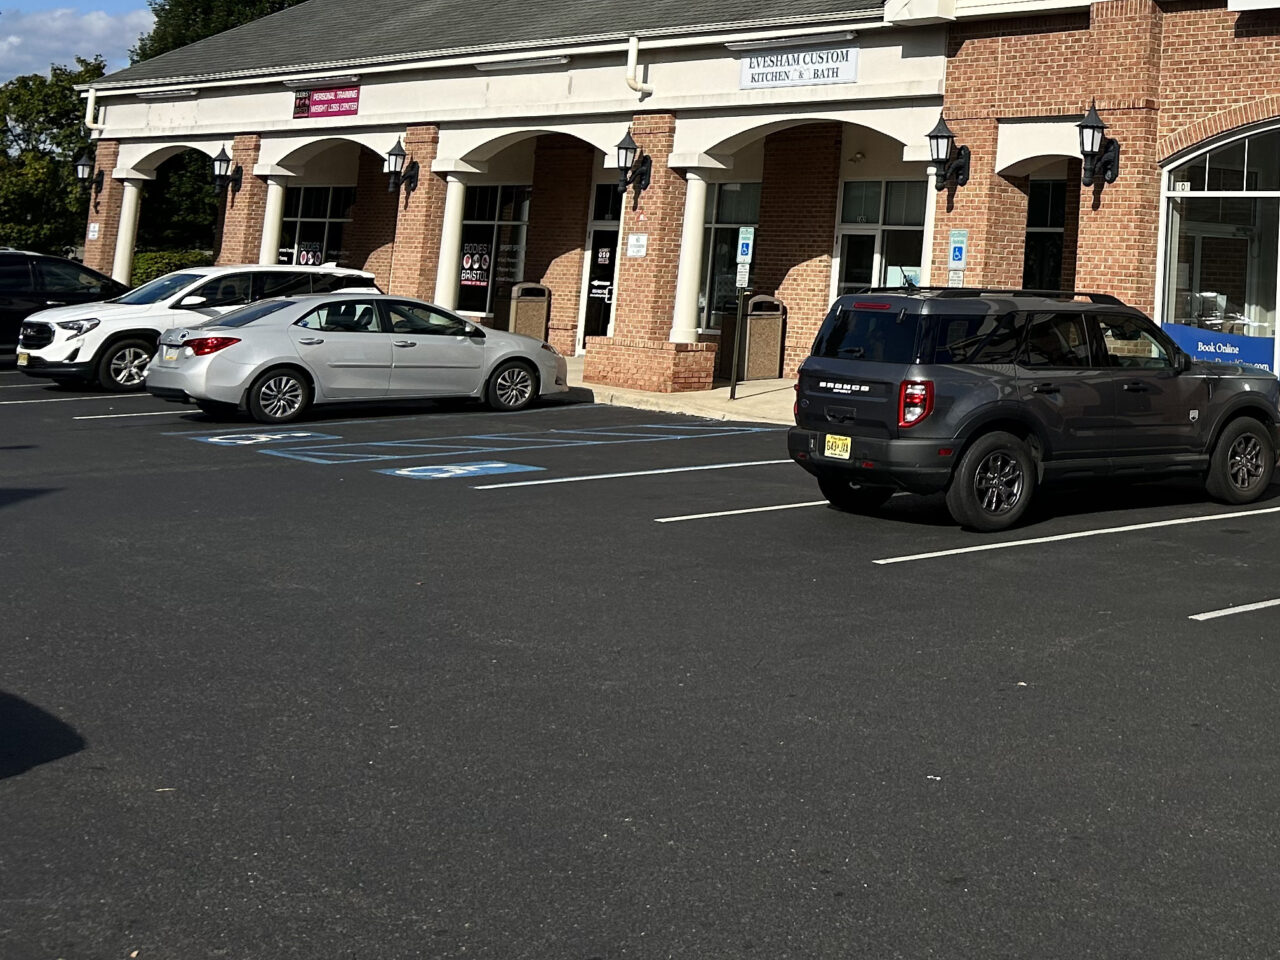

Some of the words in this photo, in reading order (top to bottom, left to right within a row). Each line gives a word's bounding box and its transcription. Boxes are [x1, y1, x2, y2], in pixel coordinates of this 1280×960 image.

[749, 54, 800, 69] EVESHAM
[802, 50, 850, 65] CUSTOM
[750, 70, 790, 83] KITCHEN
[798, 70, 804, 79] &
[813, 67, 840, 79] BATH
[313, 91, 335, 101] PERSONAL
[336, 90, 358, 99] TRAINING
[310, 104, 328, 113] WEIGHT
[328, 103, 339, 112] LOSS
[340, 101, 358, 111] CENTER
[461, 270, 488, 281] BRISTOL
[1197, 341, 1216, 353] Book
[1216, 342, 1240, 354] Online
[819, 381, 870, 392] BRONCO
